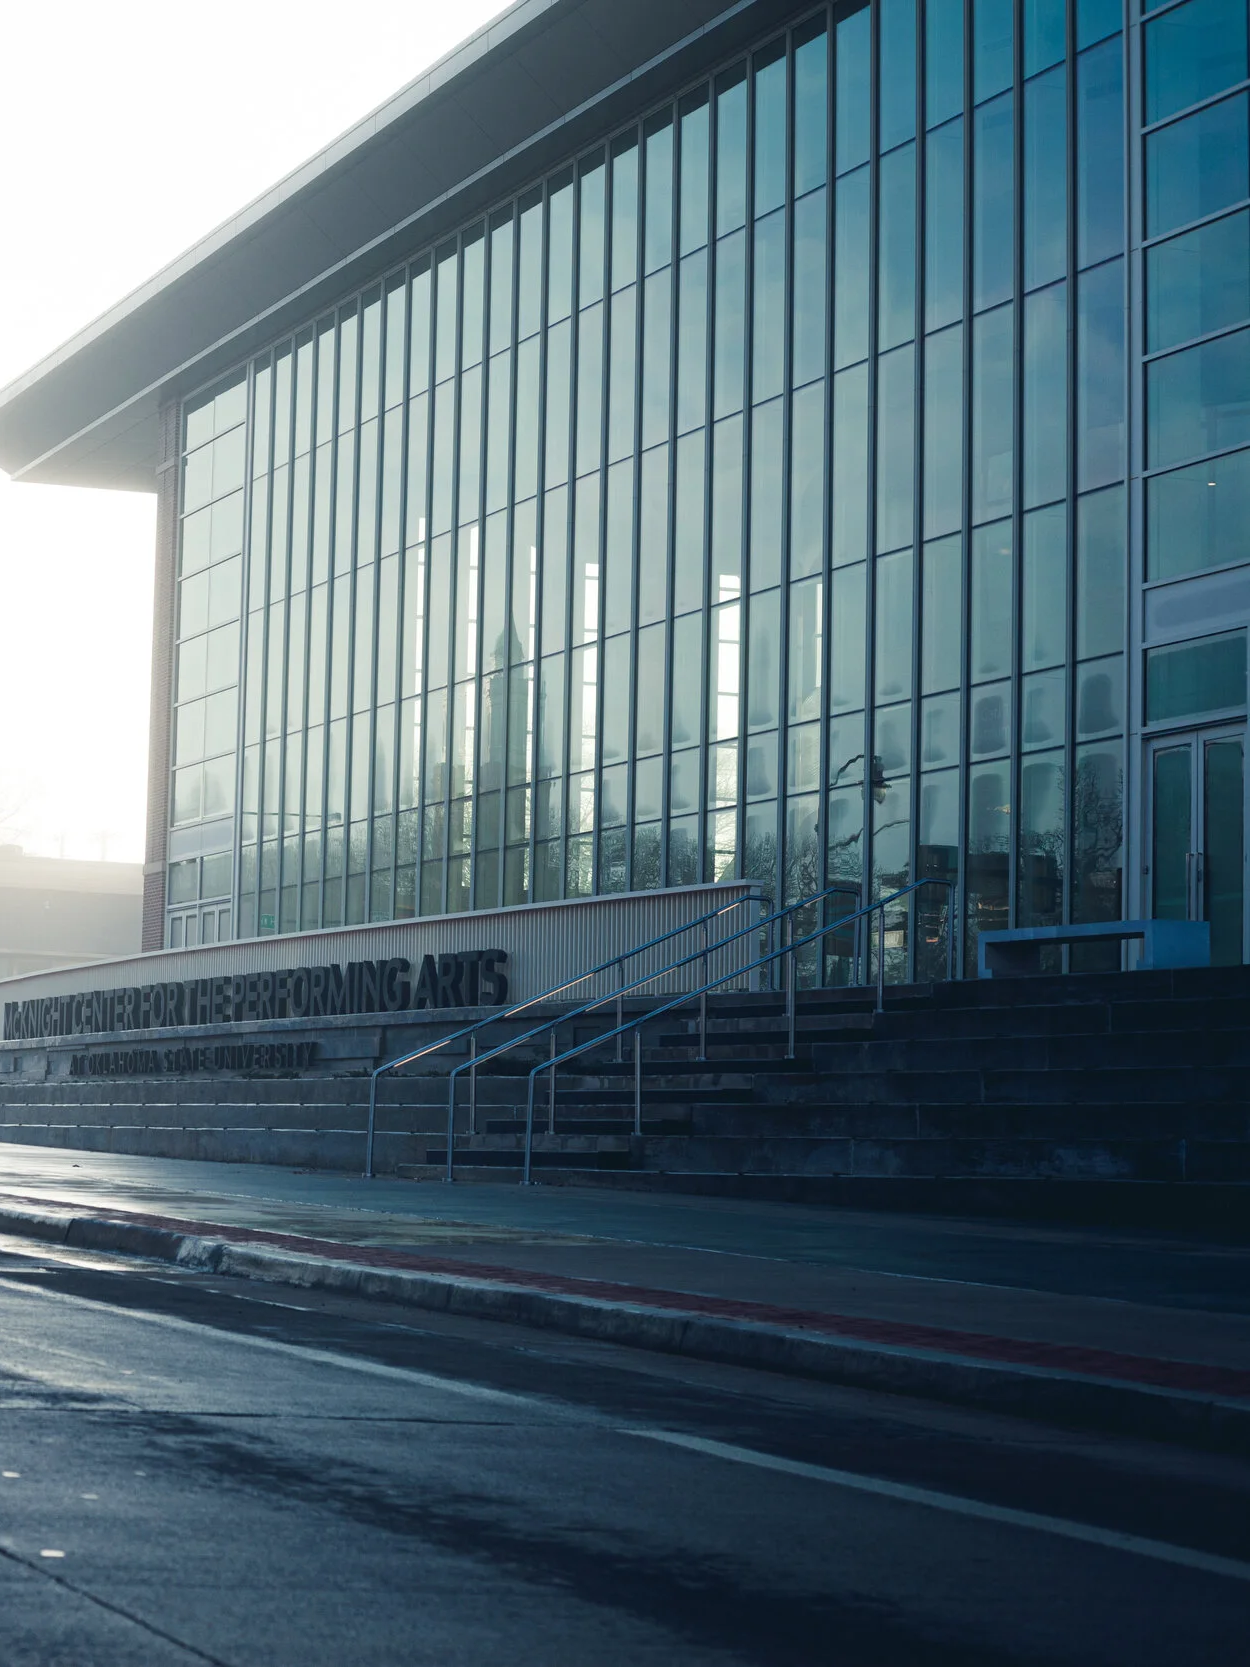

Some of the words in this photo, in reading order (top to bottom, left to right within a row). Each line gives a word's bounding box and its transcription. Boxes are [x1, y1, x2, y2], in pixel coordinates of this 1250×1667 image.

[72, 987, 139, 1034] CENTER
[139, 981, 184, 1030] FOR
[184, 975, 232, 1025] THE
[231, 957, 410, 1021] PERFORMING
[411, 948, 508, 1010] ARTS
[88, 1048, 158, 1075] OKLAHOMA
[163, 1047, 210, 1072] STATE
[214, 1042, 317, 1071] UNIVERSITY
